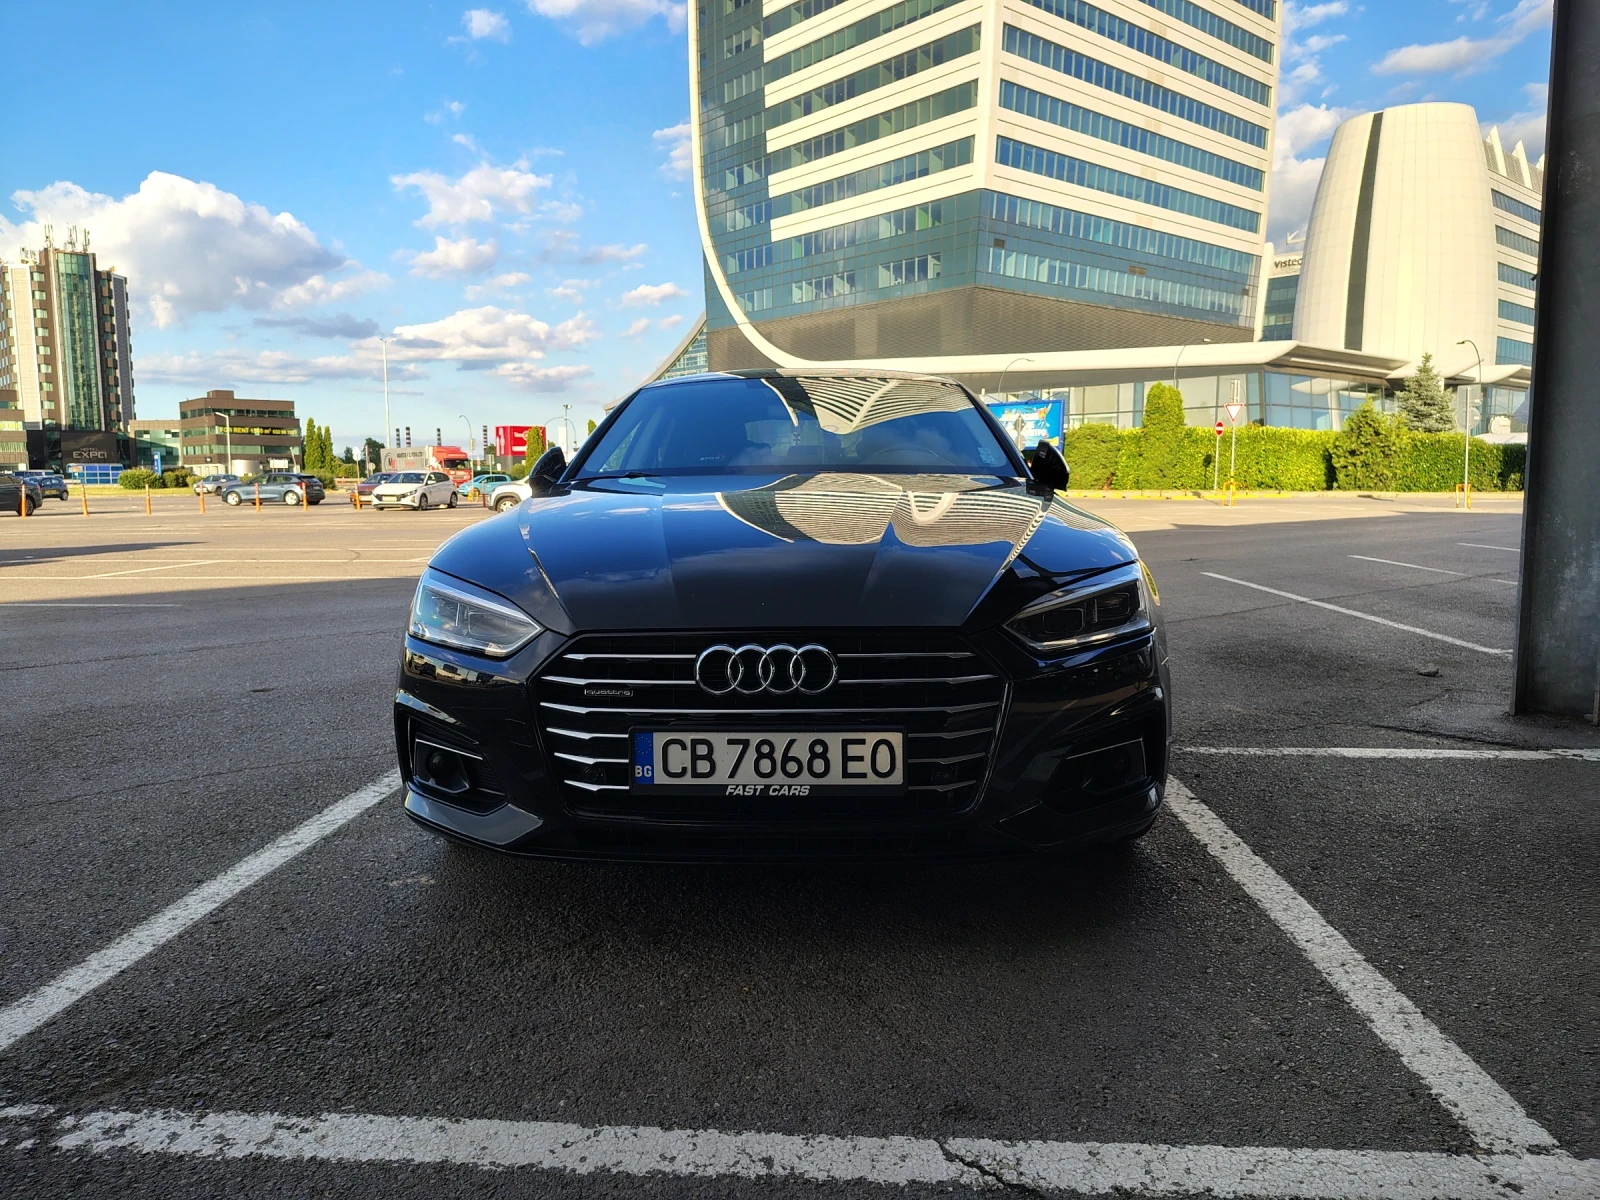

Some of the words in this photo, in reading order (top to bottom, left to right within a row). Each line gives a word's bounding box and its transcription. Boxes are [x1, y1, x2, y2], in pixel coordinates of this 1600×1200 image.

[586, 689, 631, 697] quattro
[661, 737, 717, 779] CB
[726, 737, 831, 779] 7868
[634, 765, 652, 777] BG
[725, 785, 764, 796] FAST
[768, 785, 810, 796] CARS
